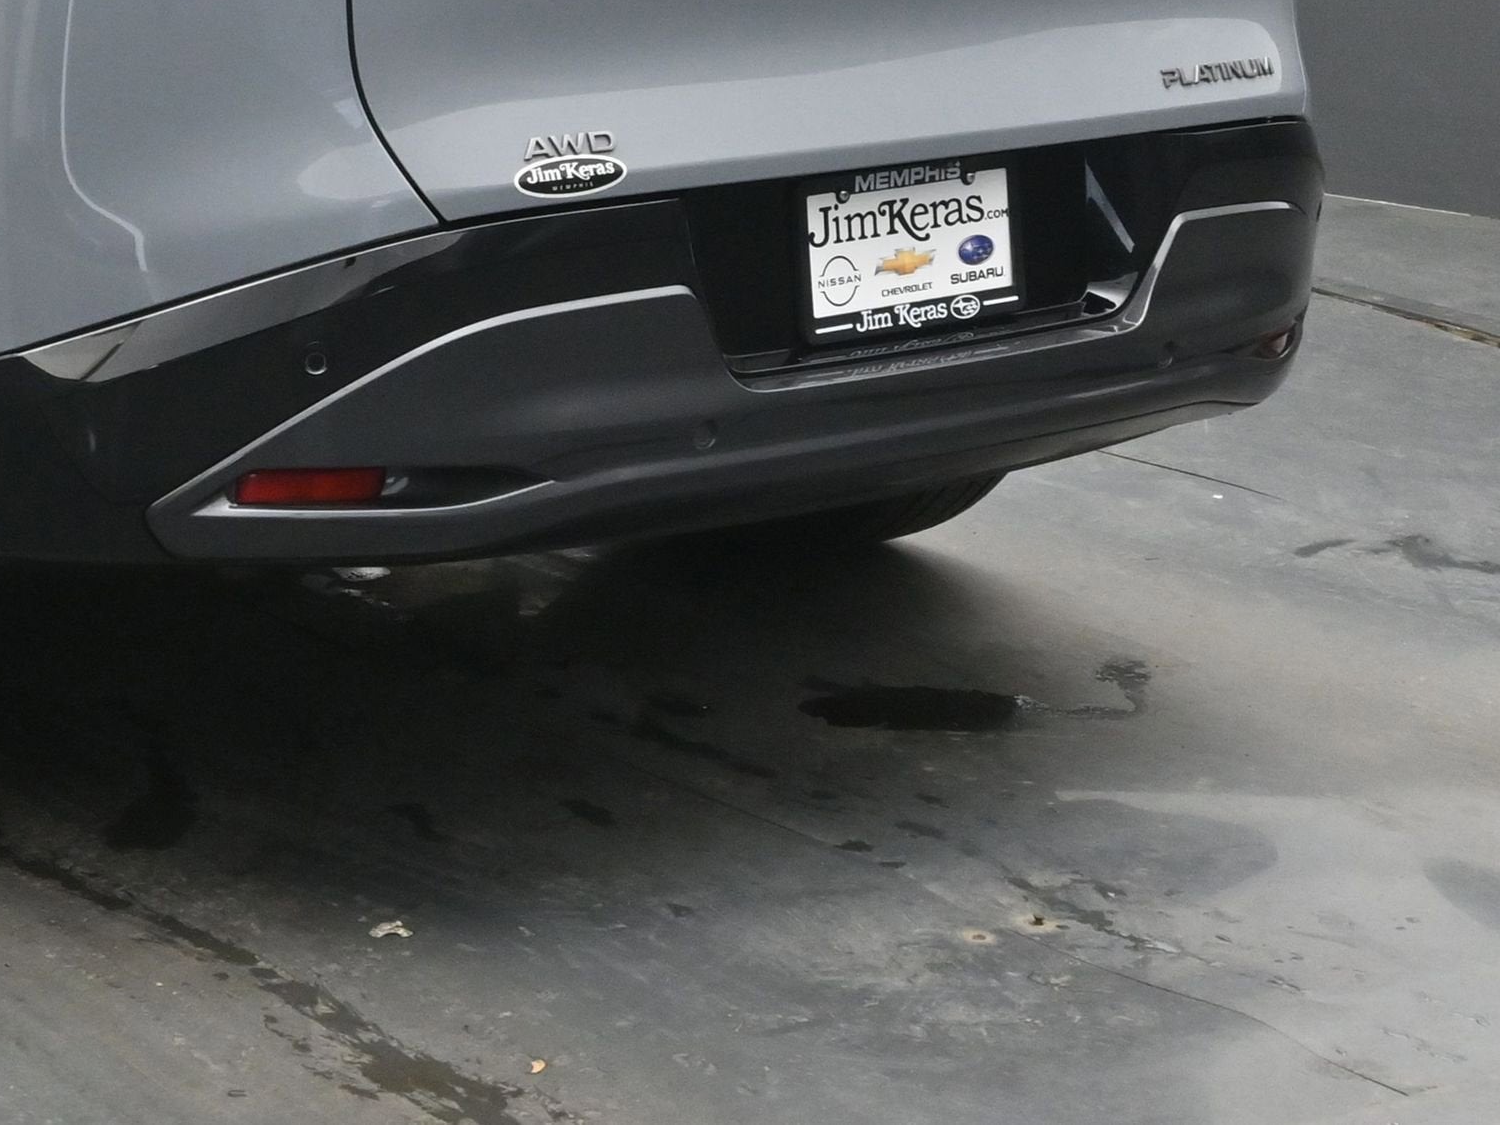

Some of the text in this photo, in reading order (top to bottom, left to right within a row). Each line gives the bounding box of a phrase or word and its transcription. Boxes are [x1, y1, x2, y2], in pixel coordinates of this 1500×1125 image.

[1160, 56, 1274, 89] PLATINUM
[524, 131, 615, 161] AWD
[855, 162, 960, 192] MEMPHIS
[818, 275, 862, 288] NISSAN
[881, 282, 933, 298] CHEVROLET
[950, 267, 1004, 285] SUBARU
[856, 303, 948, 332] Jim Keras
